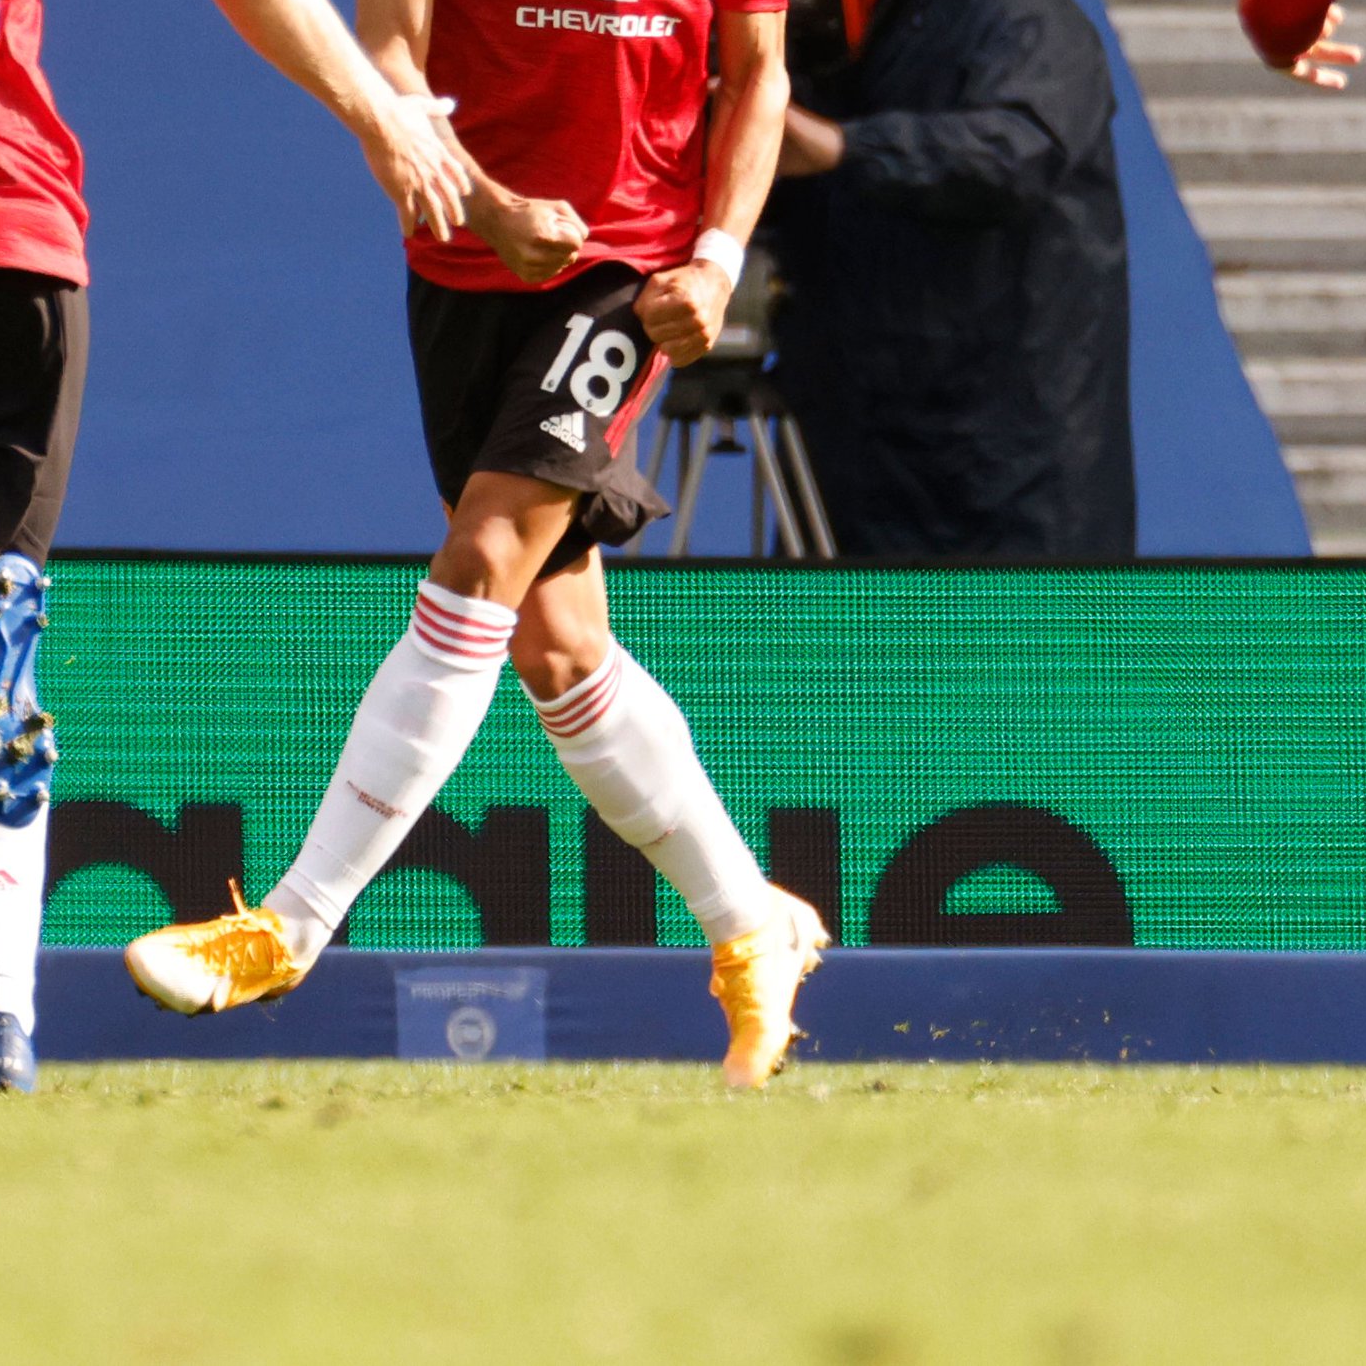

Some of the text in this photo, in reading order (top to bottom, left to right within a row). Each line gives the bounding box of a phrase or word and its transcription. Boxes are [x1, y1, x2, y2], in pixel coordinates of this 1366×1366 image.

[516, 6, 682, 38] CHEVROLET
[540, 312, 637, 418] 18
[539, 420, 586, 454] adidas
